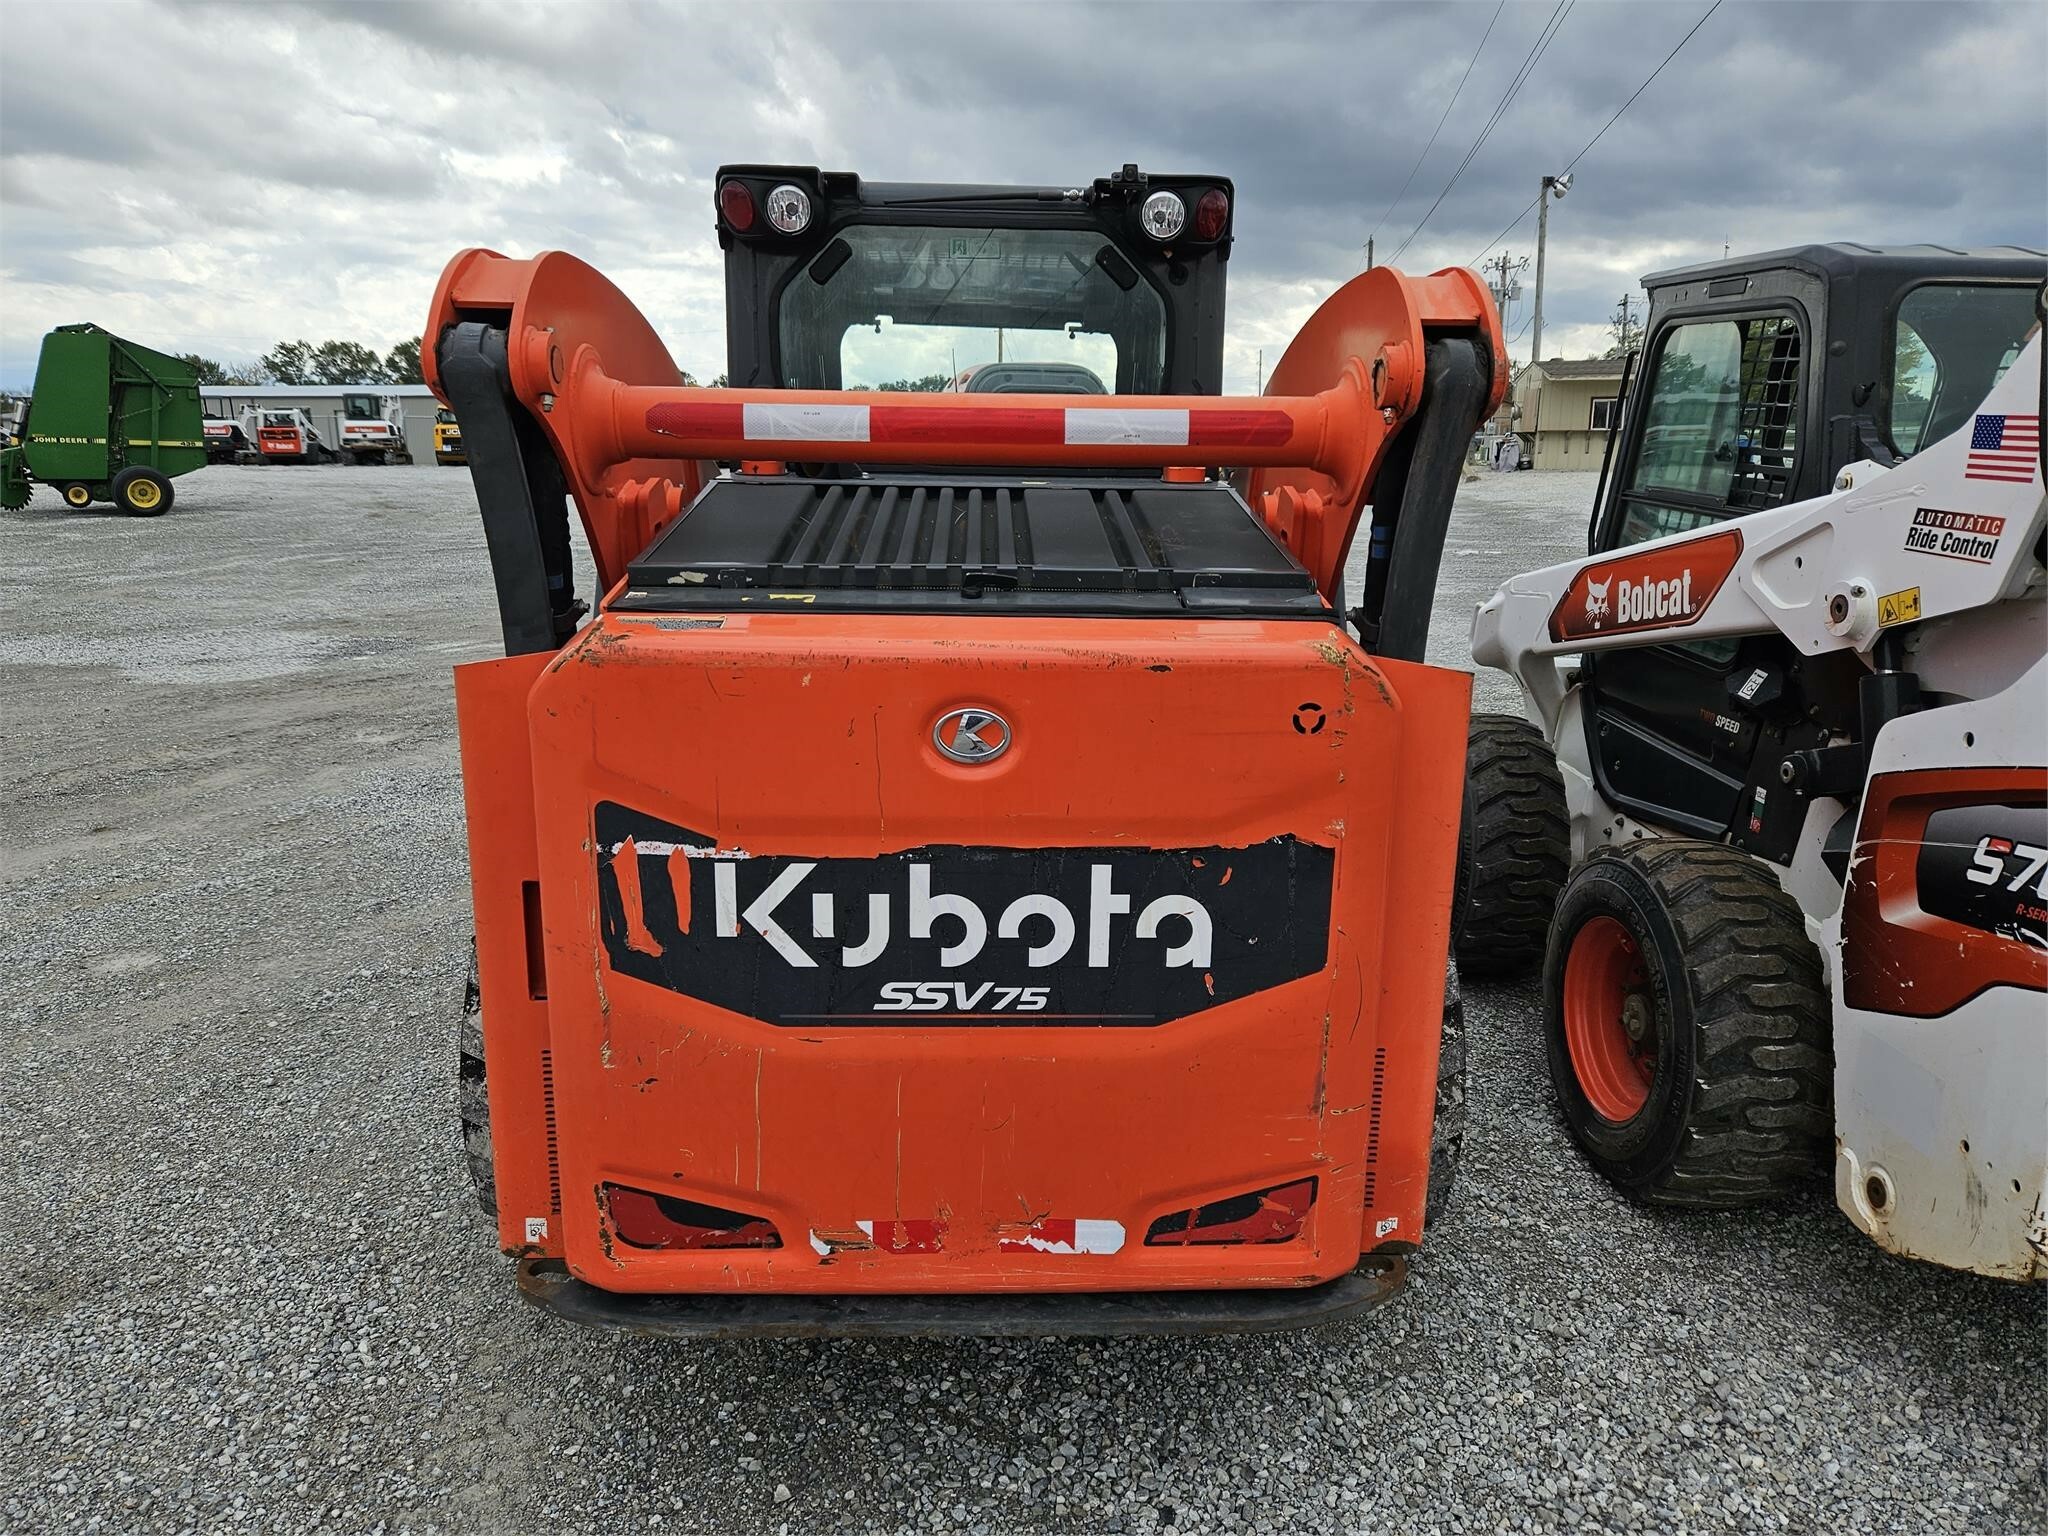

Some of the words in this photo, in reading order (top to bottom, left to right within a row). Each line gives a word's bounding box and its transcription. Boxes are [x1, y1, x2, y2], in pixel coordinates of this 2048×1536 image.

[33, 436, 57, 444] JOHN
[1916, 510, 2001, 535] AUTOMATIC
[1905, 526, 1939, 550] Ride
[1941, 531, 2000, 560] Control
[1617, 568, 1692, 624] Bobcat
[1715, 714, 1741, 734] SPEED
[713, 862, 1213, 968] Kubota
[2015, 903, 2048, 923] R-SER
